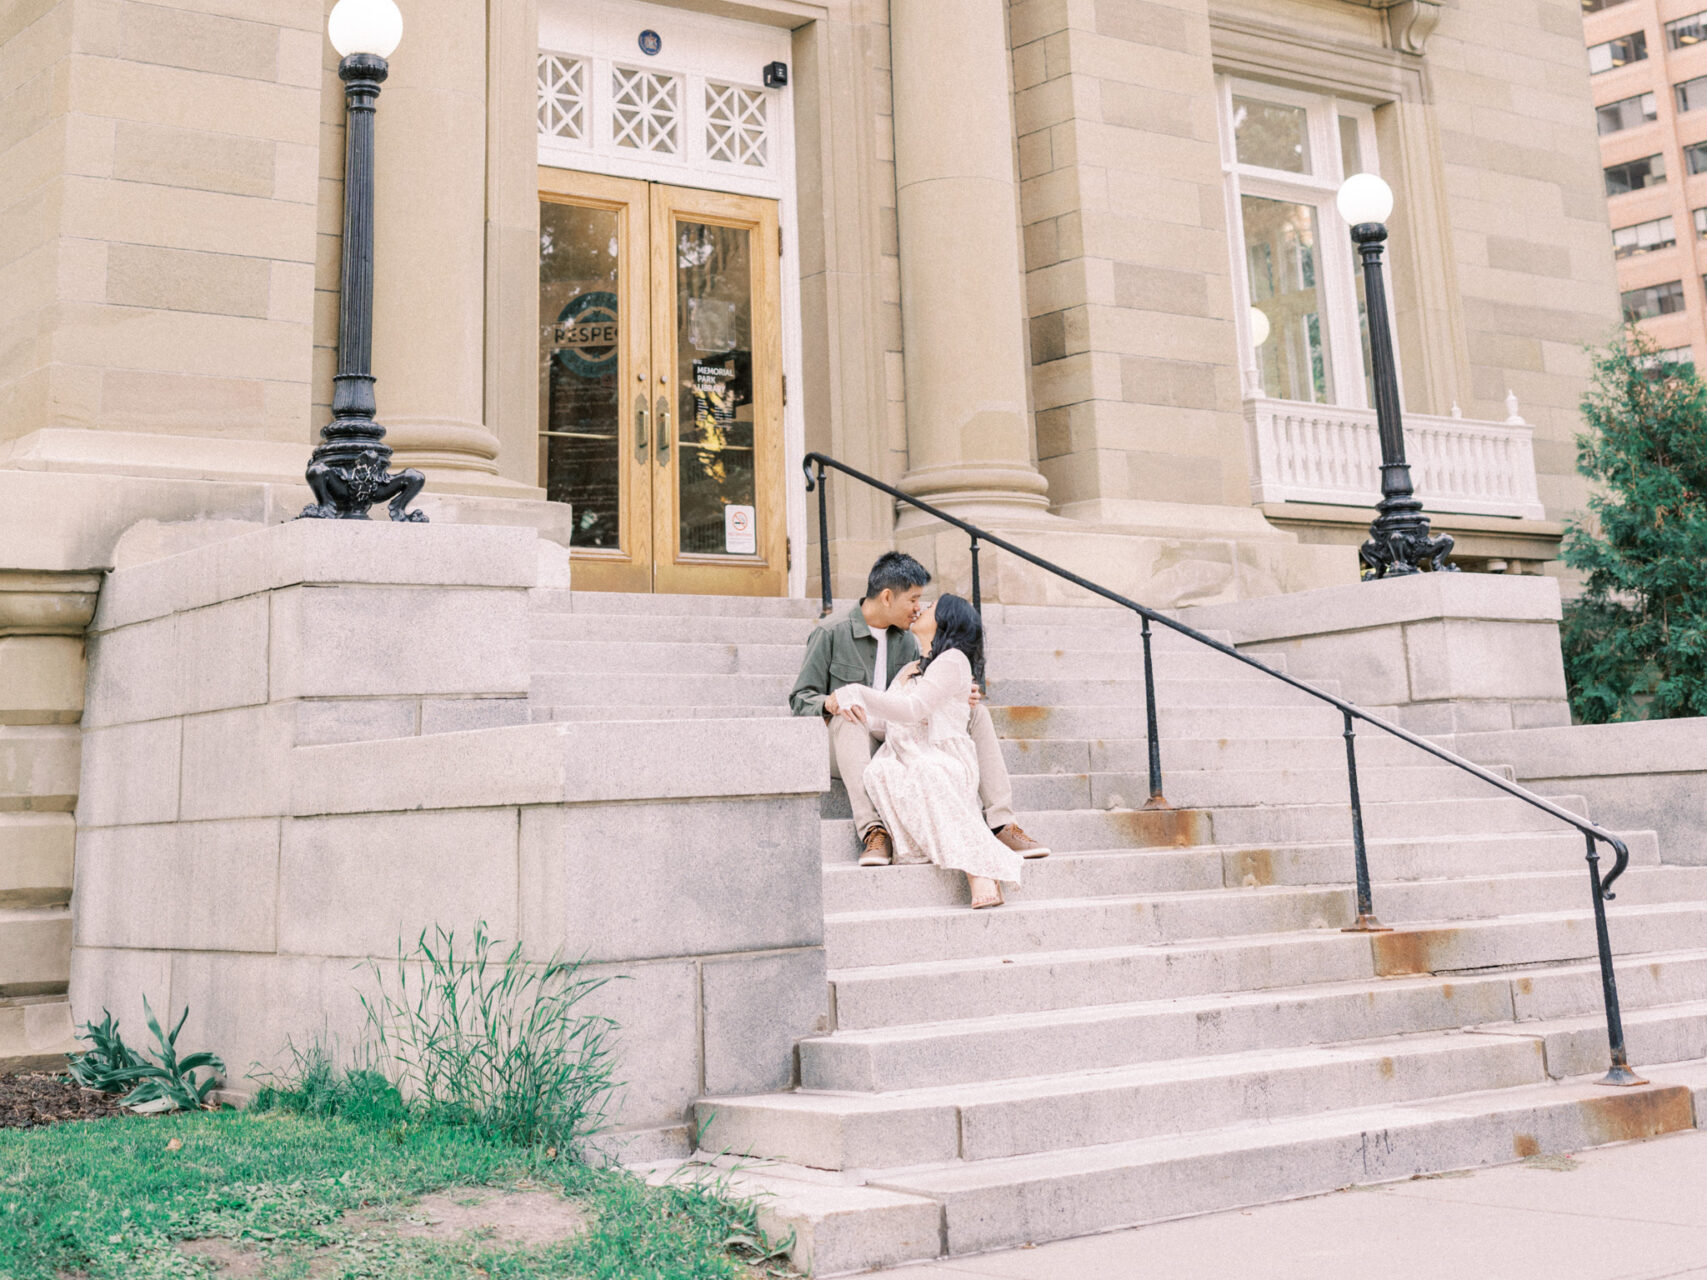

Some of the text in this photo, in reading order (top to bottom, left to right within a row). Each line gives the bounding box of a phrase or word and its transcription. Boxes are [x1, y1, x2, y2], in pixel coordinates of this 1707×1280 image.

[554, 326, 618, 344] RESPE
[697, 366, 734, 377] MEMORIAL
[697, 375, 716, 384] PARK
[697, 383, 727, 393] LIBRARY
